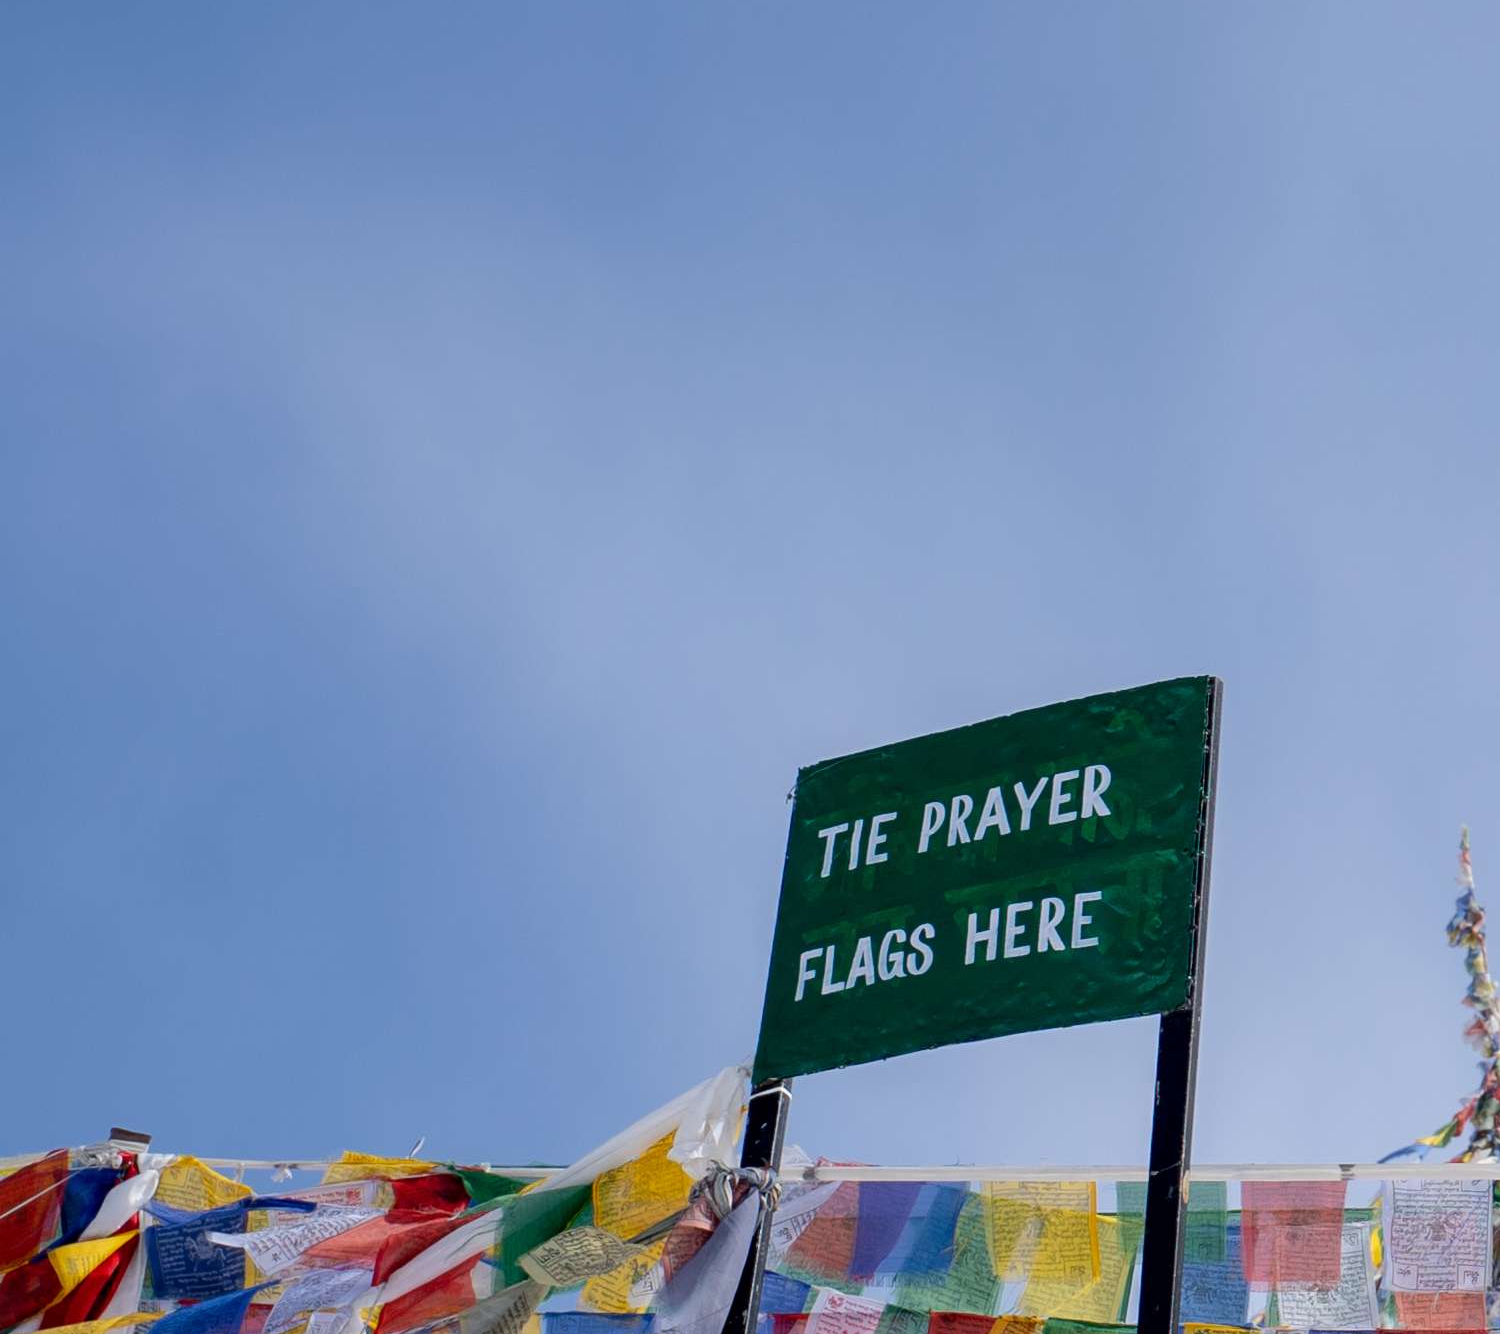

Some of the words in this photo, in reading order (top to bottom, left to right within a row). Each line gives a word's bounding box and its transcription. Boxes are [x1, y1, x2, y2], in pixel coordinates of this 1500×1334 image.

[819, 812, 896, 877] TIE
[918, 765, 1111, 853] PRAYER
[795, 924, 934, 1001] FLAGS
[965, 891, 1101, 964] HERE
